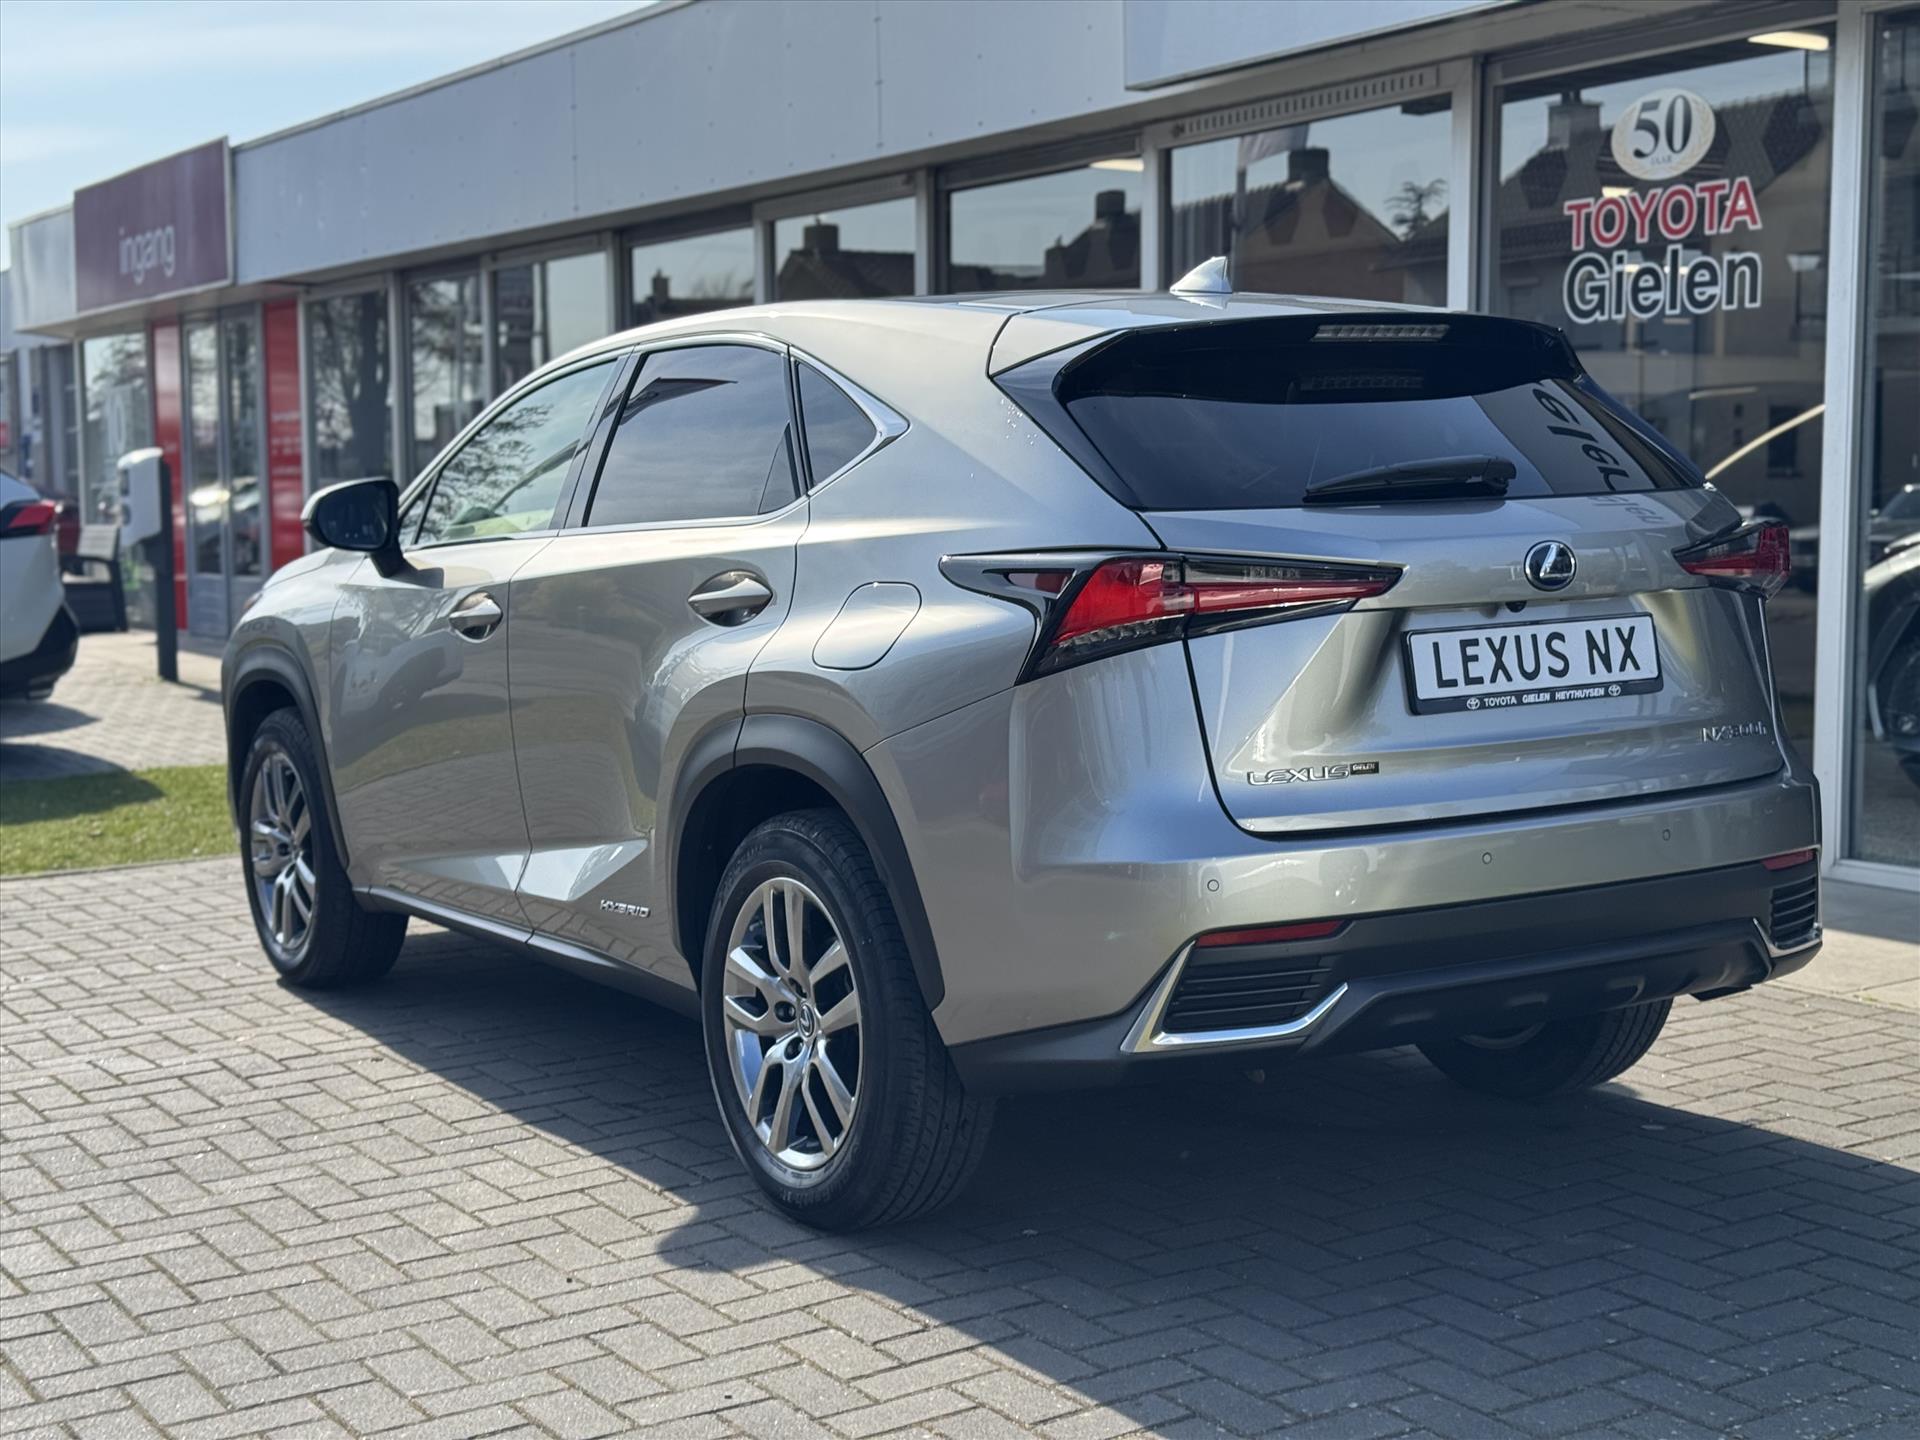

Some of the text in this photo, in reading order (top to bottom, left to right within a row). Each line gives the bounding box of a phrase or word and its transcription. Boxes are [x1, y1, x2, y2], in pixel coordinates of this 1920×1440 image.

[1632, 93, 1694, 159] 50
[1563, 175, 1763, 251] TOYOTA
[118, 225, 175, 286] ingang
[1563, 244, 1762, 324] Gielen
[1432, 625, 1641, 688] LEXUS NX
[1483, 687, 1605, 707] TOYOTA GIELEN HEYTHUYSEN
[1247, 764, 1349, 786] LEXUS
[600, 899, 651, 918] HYBRID
